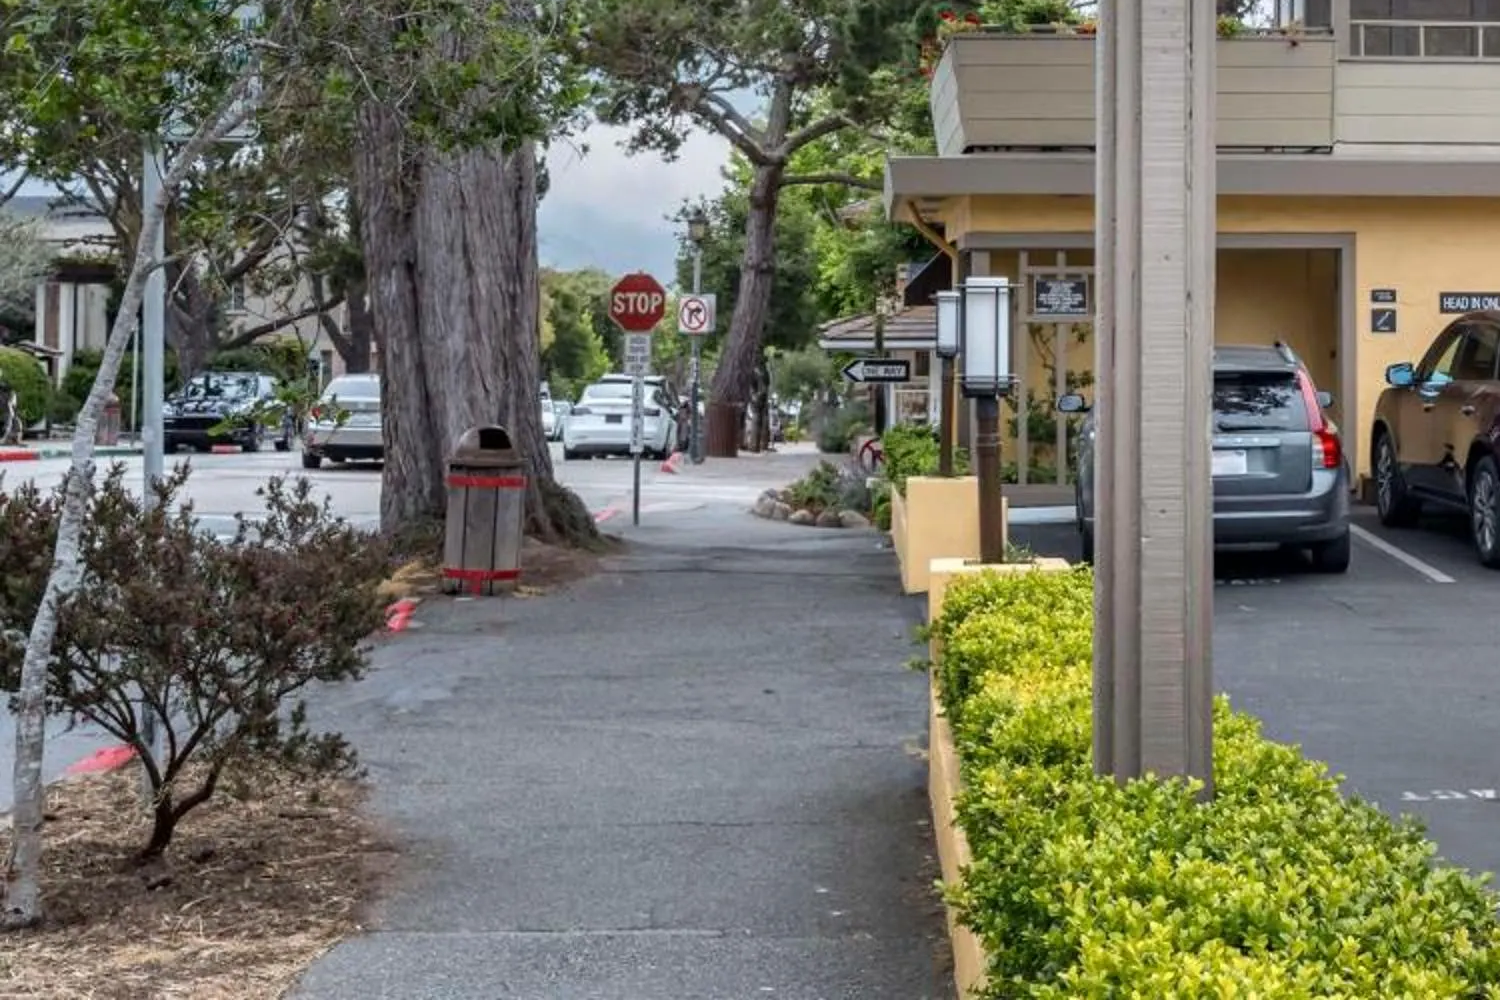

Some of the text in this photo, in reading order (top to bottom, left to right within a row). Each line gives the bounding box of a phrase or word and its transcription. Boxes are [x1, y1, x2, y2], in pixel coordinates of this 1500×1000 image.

[613, 291, 662, 314] STOP
[1443, 296, 1468, 309] HEAD
[1471, 296, 1481, 309] IN
